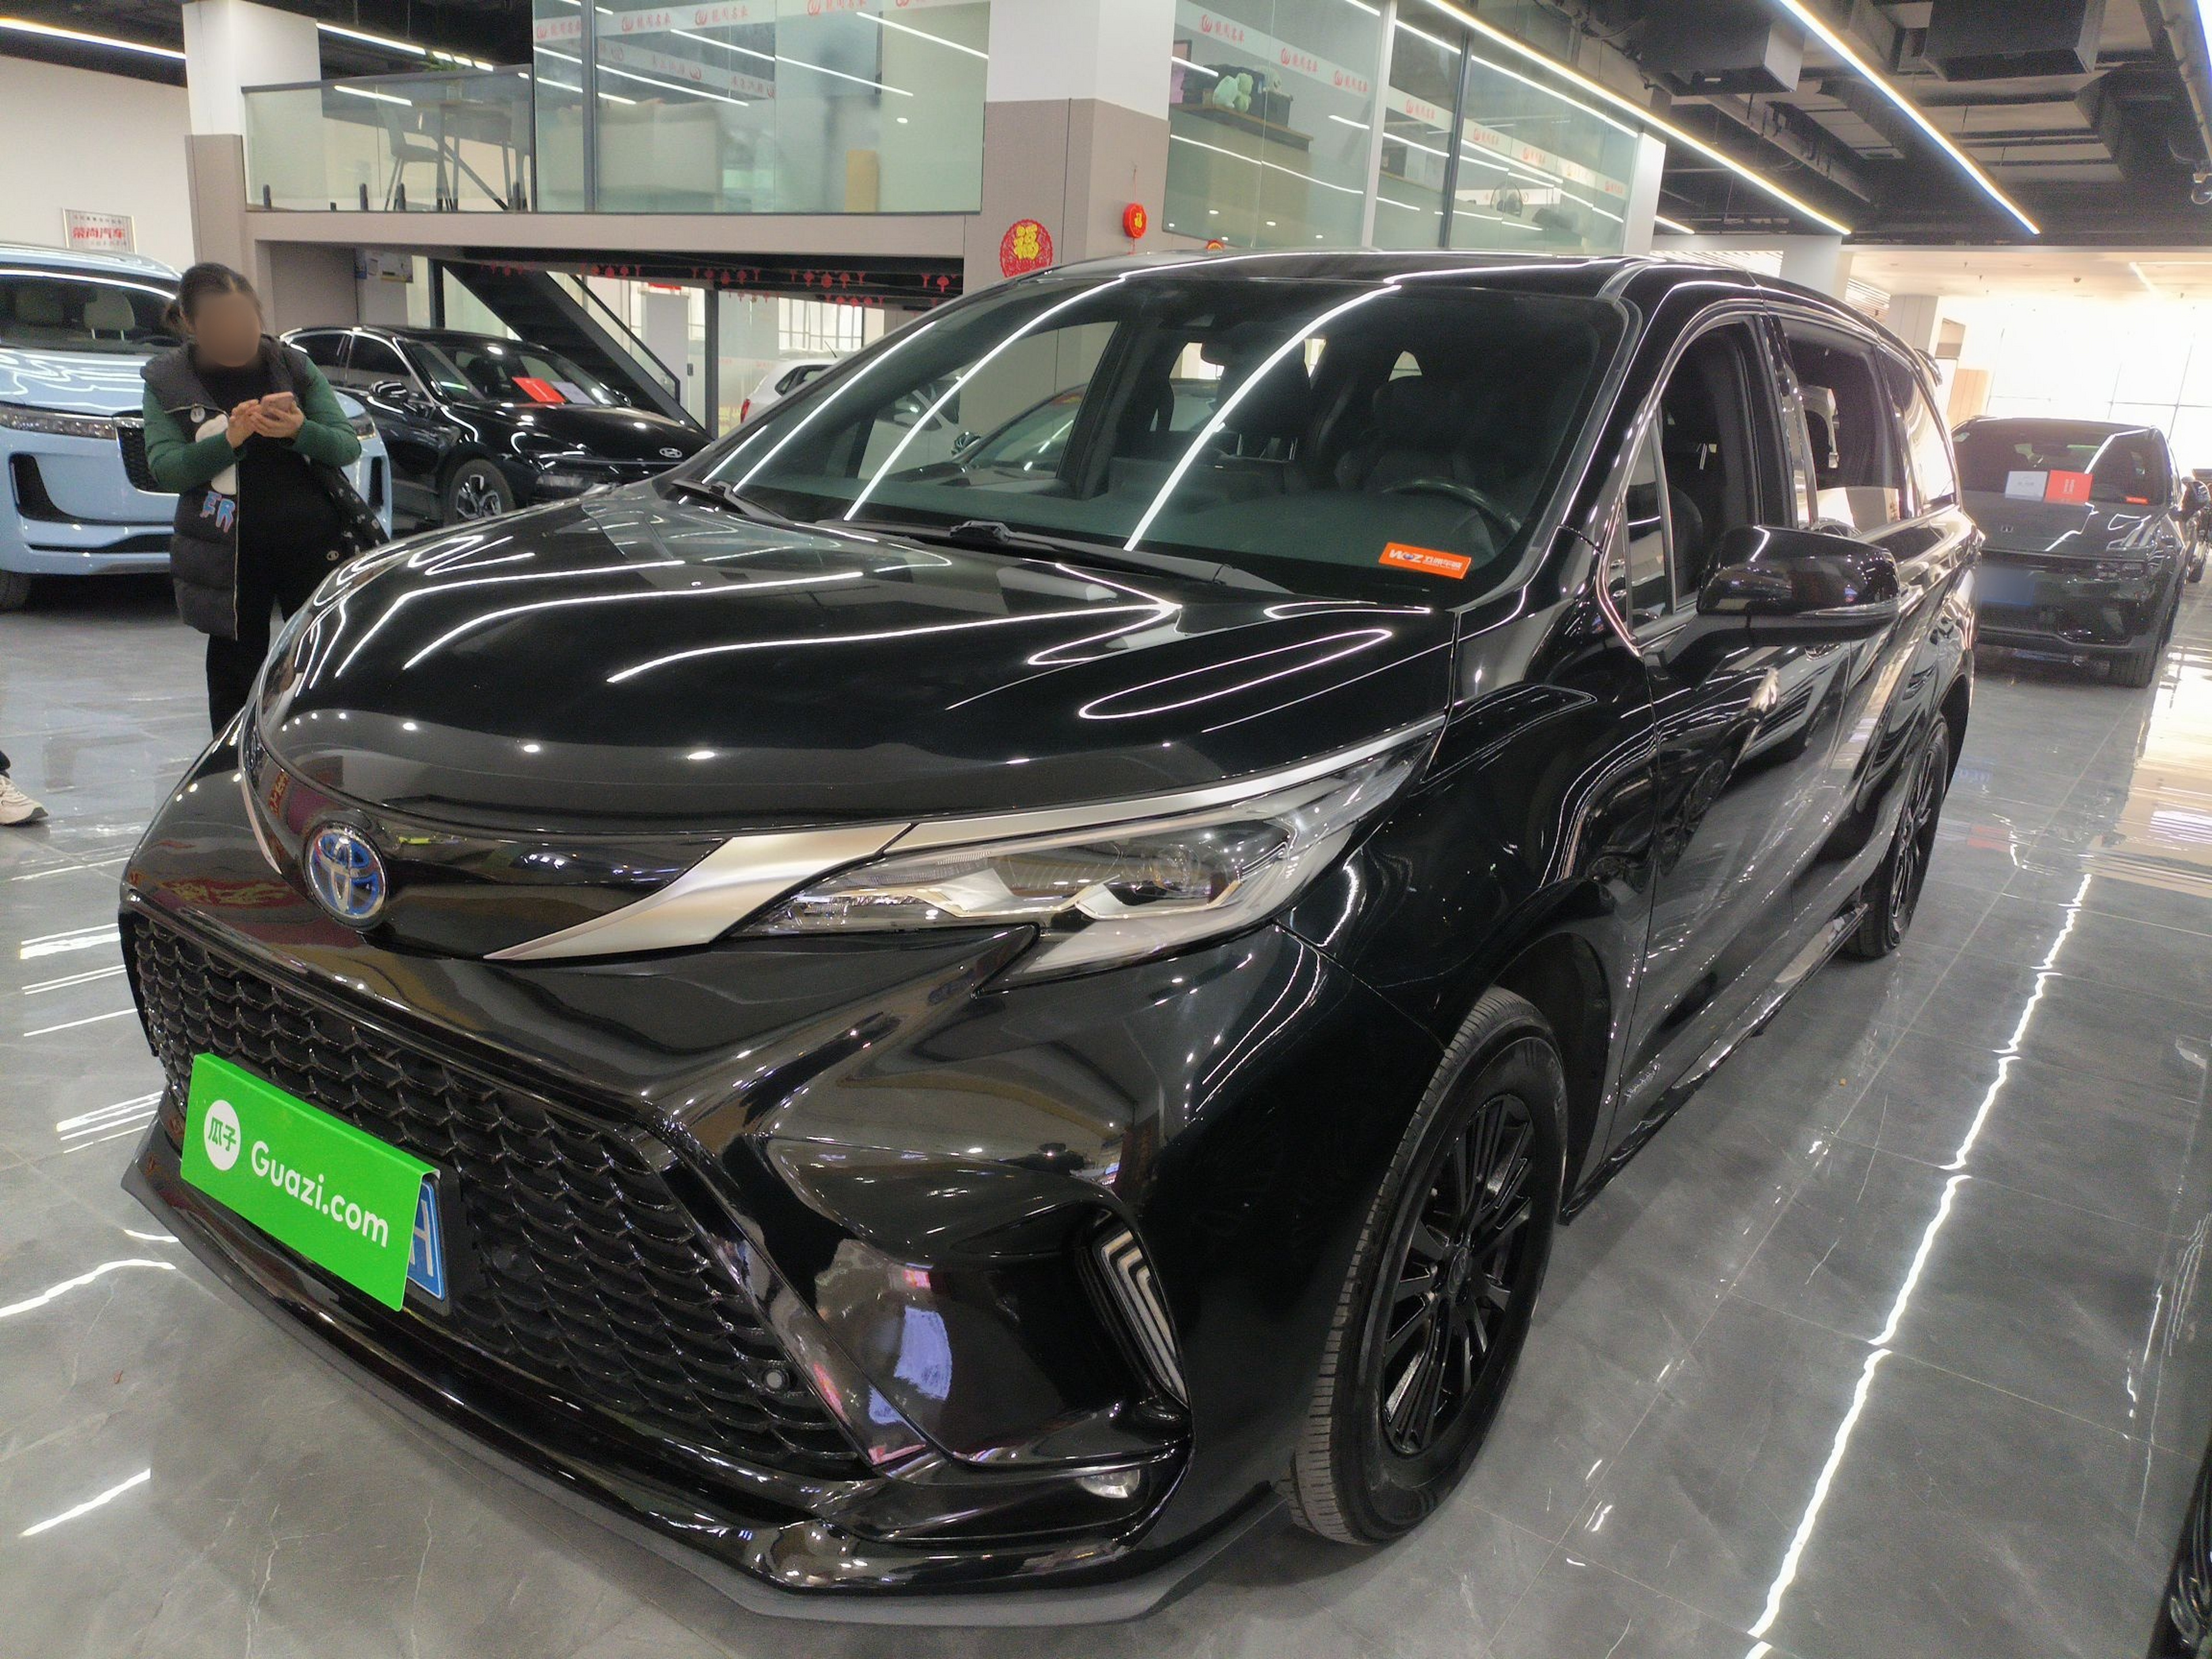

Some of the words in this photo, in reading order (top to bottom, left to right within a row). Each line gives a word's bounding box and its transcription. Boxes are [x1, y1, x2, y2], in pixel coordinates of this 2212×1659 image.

[1013, 224, 1040, 260] 福
[208, 1117, 237, 1152] 瓜子
[251, 1140, 389, 1248] Guazi.com
